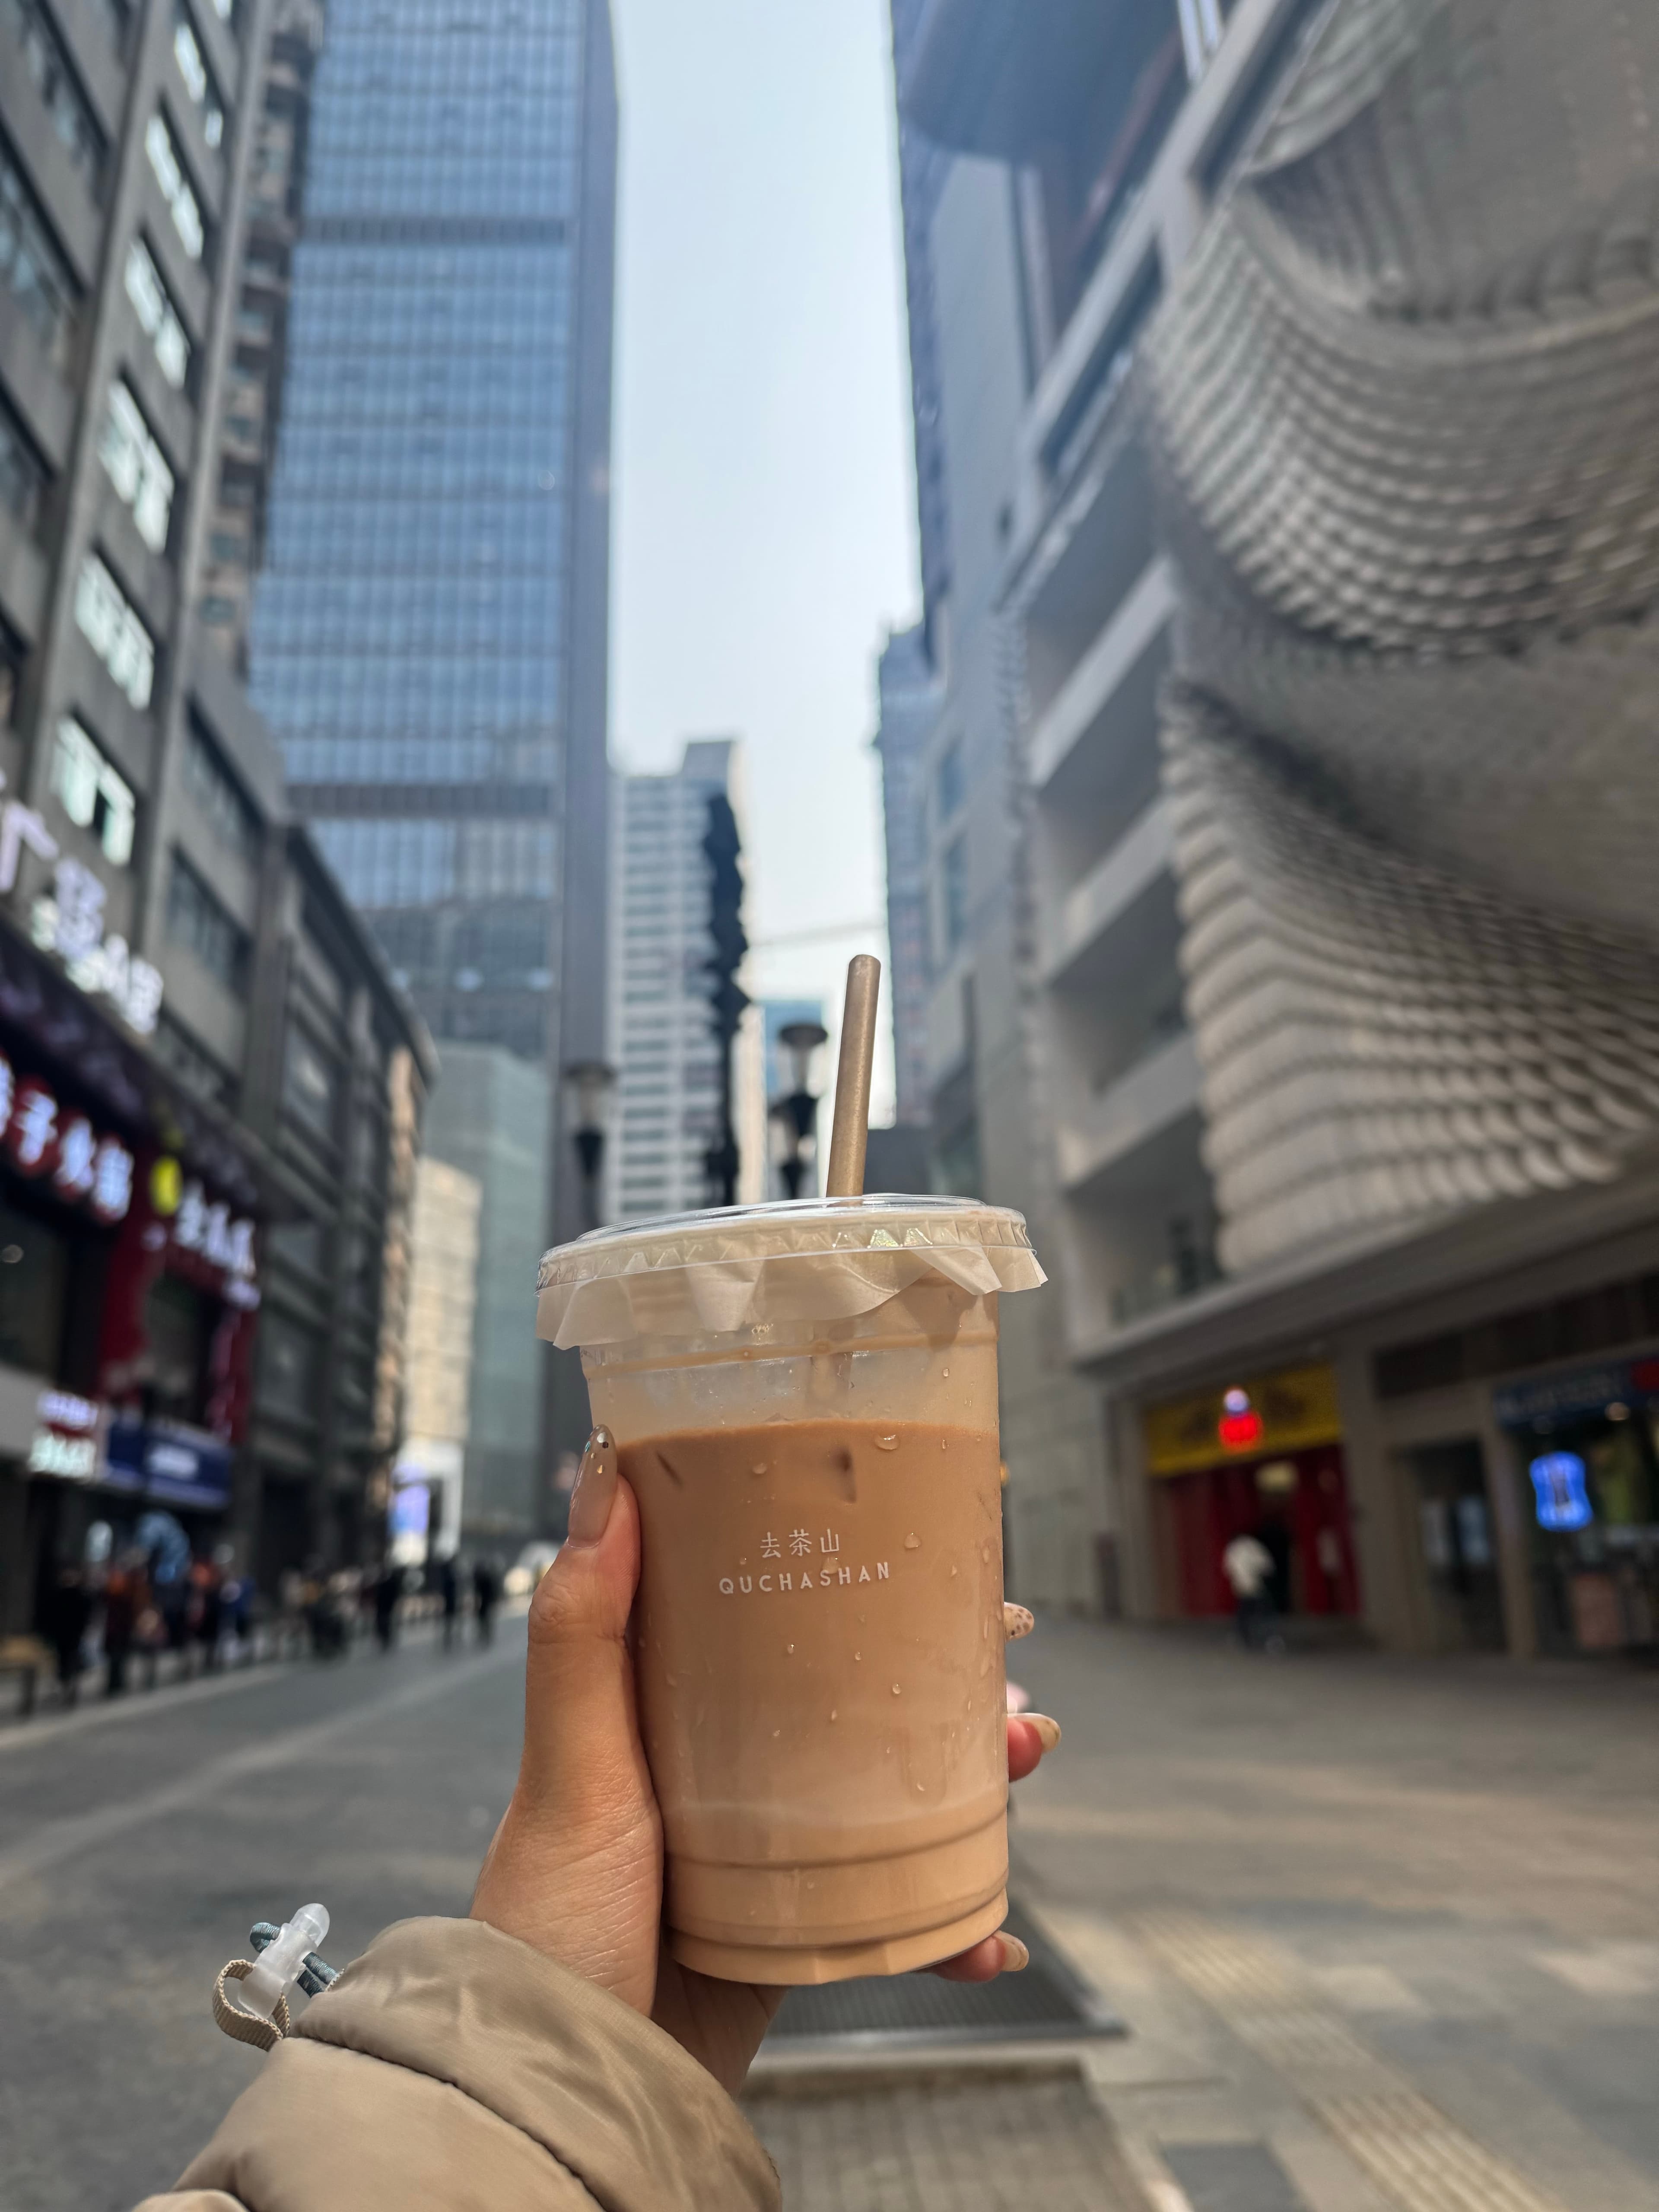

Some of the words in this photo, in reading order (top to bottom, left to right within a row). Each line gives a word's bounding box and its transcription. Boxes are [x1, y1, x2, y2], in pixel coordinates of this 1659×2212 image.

[760, 1528, 840, 1558] 去茶山
[719, 1562, 889, 1594] QUCHASHAN
